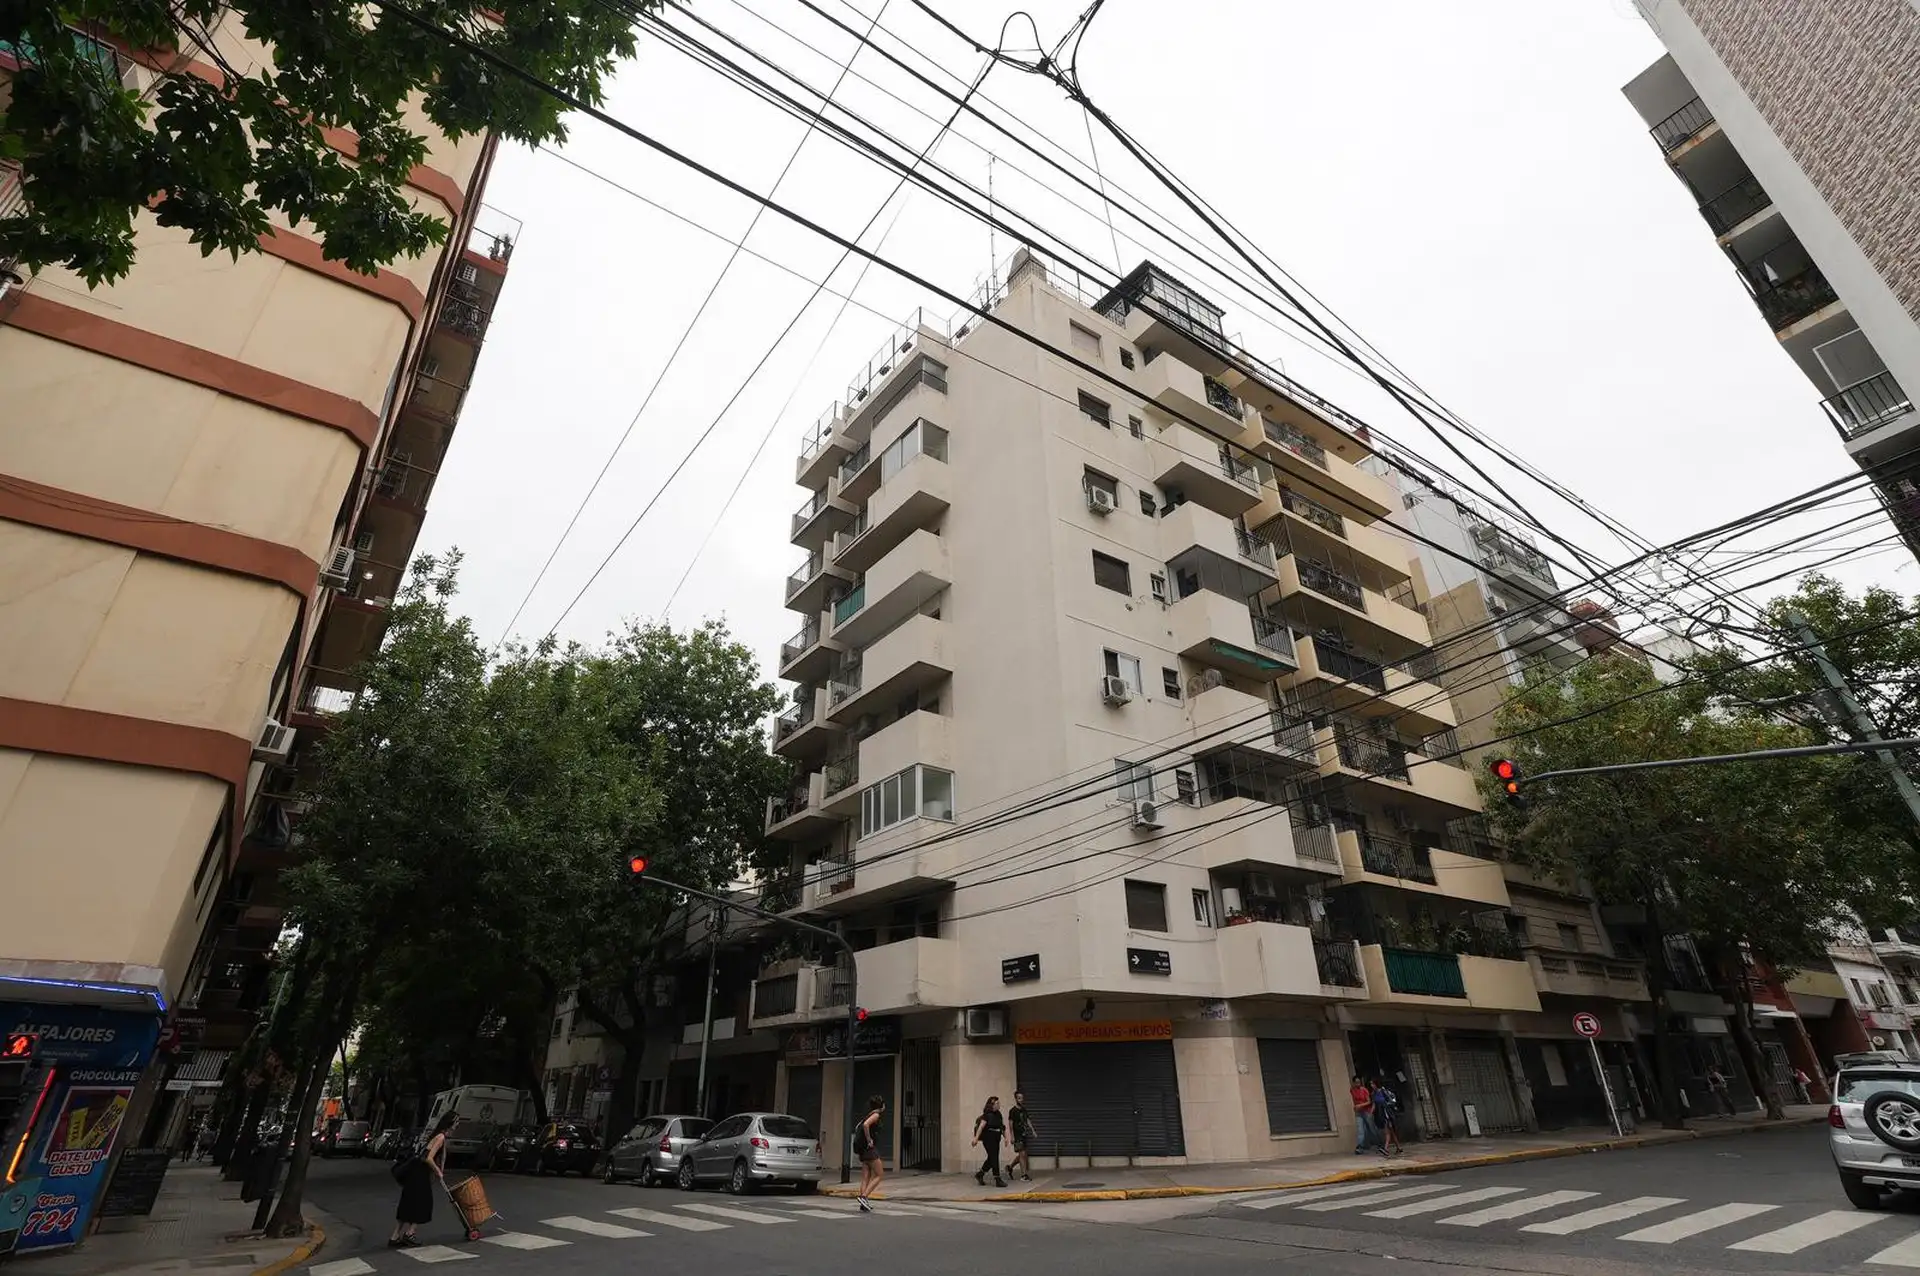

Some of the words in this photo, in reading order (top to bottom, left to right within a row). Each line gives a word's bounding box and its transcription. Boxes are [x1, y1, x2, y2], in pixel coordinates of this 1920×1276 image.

[69, 1070, 141, 1081] CHOCOLATE
[49, 1151, 82, 1163] DATE
[84, 1149, 103, 1162] UN
[49, 1163, 92, 1177] GUSTO
[22, 1207, 78, 1236] 724
